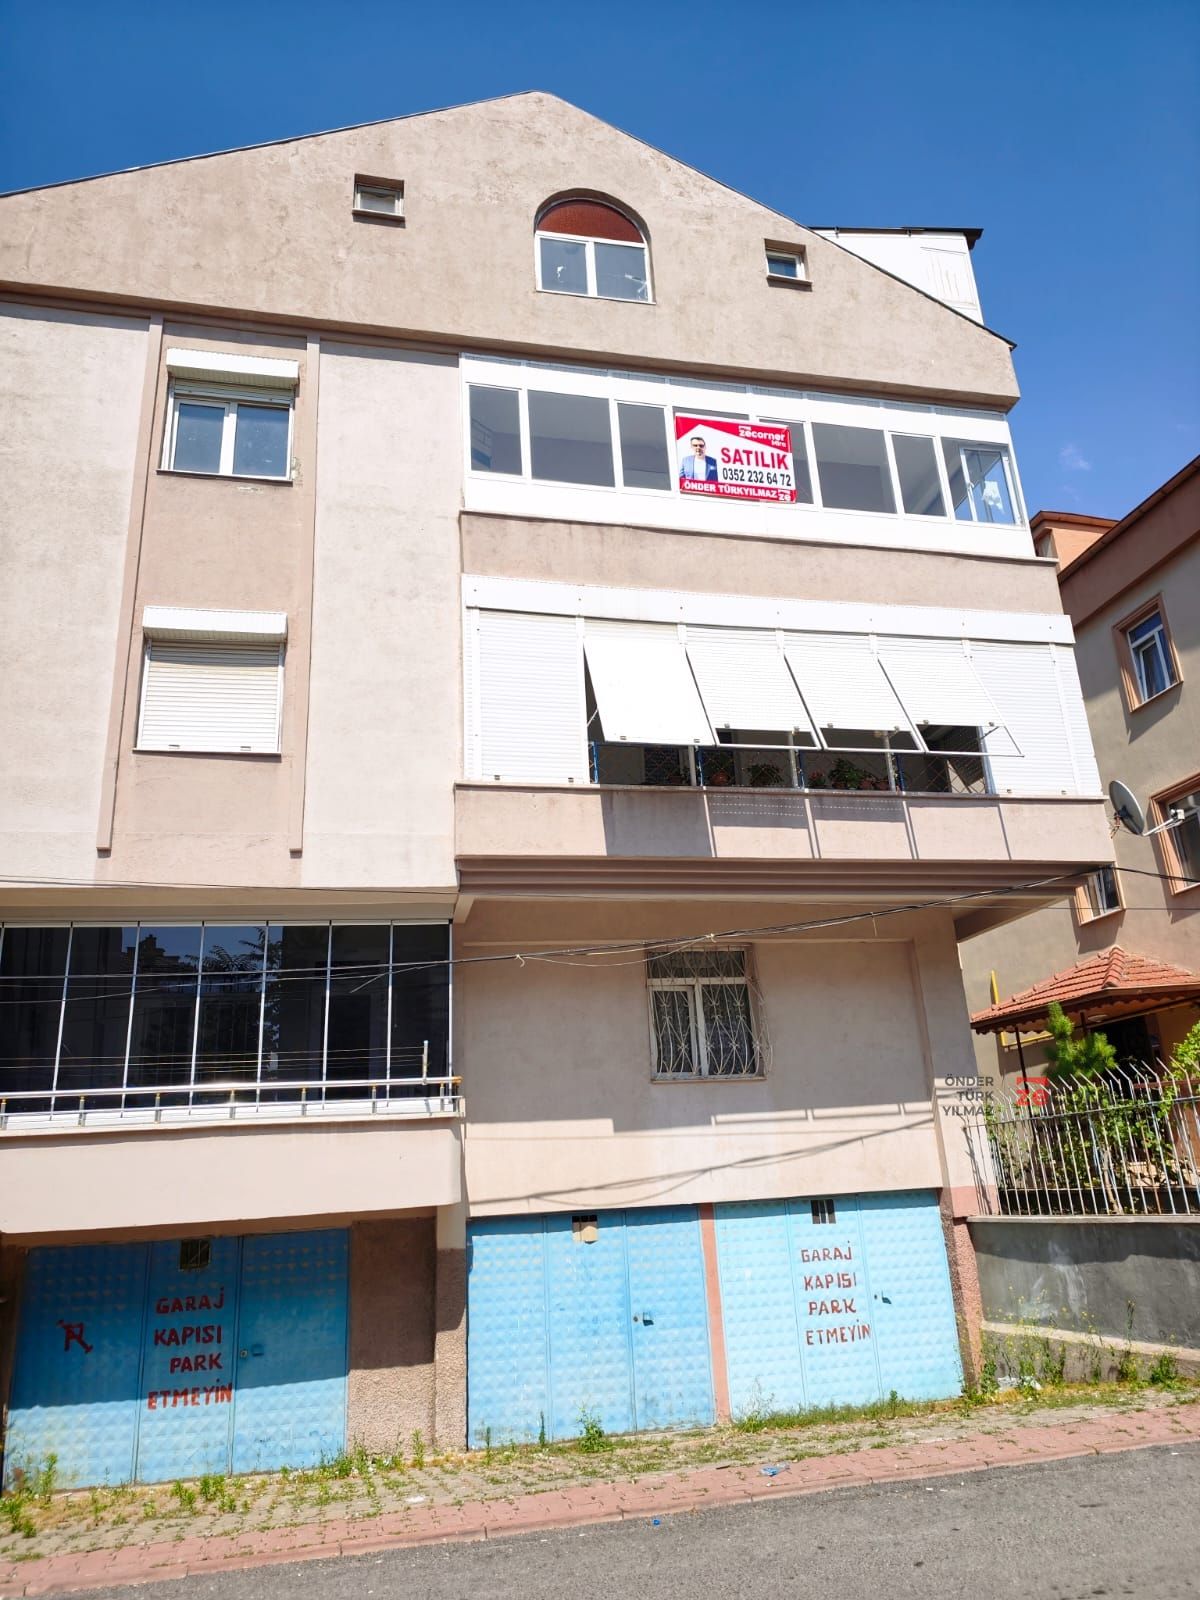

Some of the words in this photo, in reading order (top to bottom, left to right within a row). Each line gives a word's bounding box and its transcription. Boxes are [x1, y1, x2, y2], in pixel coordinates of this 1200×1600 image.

[721, 448, 789, 470] SATILIK
[723, 468, 745, 482] 0352
[748, 470, 764, 484] 232
[766, 472, 778, 485] 64
[780, 474, 792, 487] 72
[684, 481, 716, 492] ÖNDER
[718, 484, 778, 499] TÜRKYILMAZ
[801, 1240, 852, 1263] GARAJ
[804, 1272, 857, 1291] KAPISI
[156, 1287, 225, 1314] GARAJ
[809, 1298, 856, 1315] PARK
[154, 1325, 222, 1346] KAPISI
[806, 1319, 871, 1346] ETMEYİN
[170, 1353, 223, 1374] PARK
[147, 1379, 233, 1410] ETMEYİN
